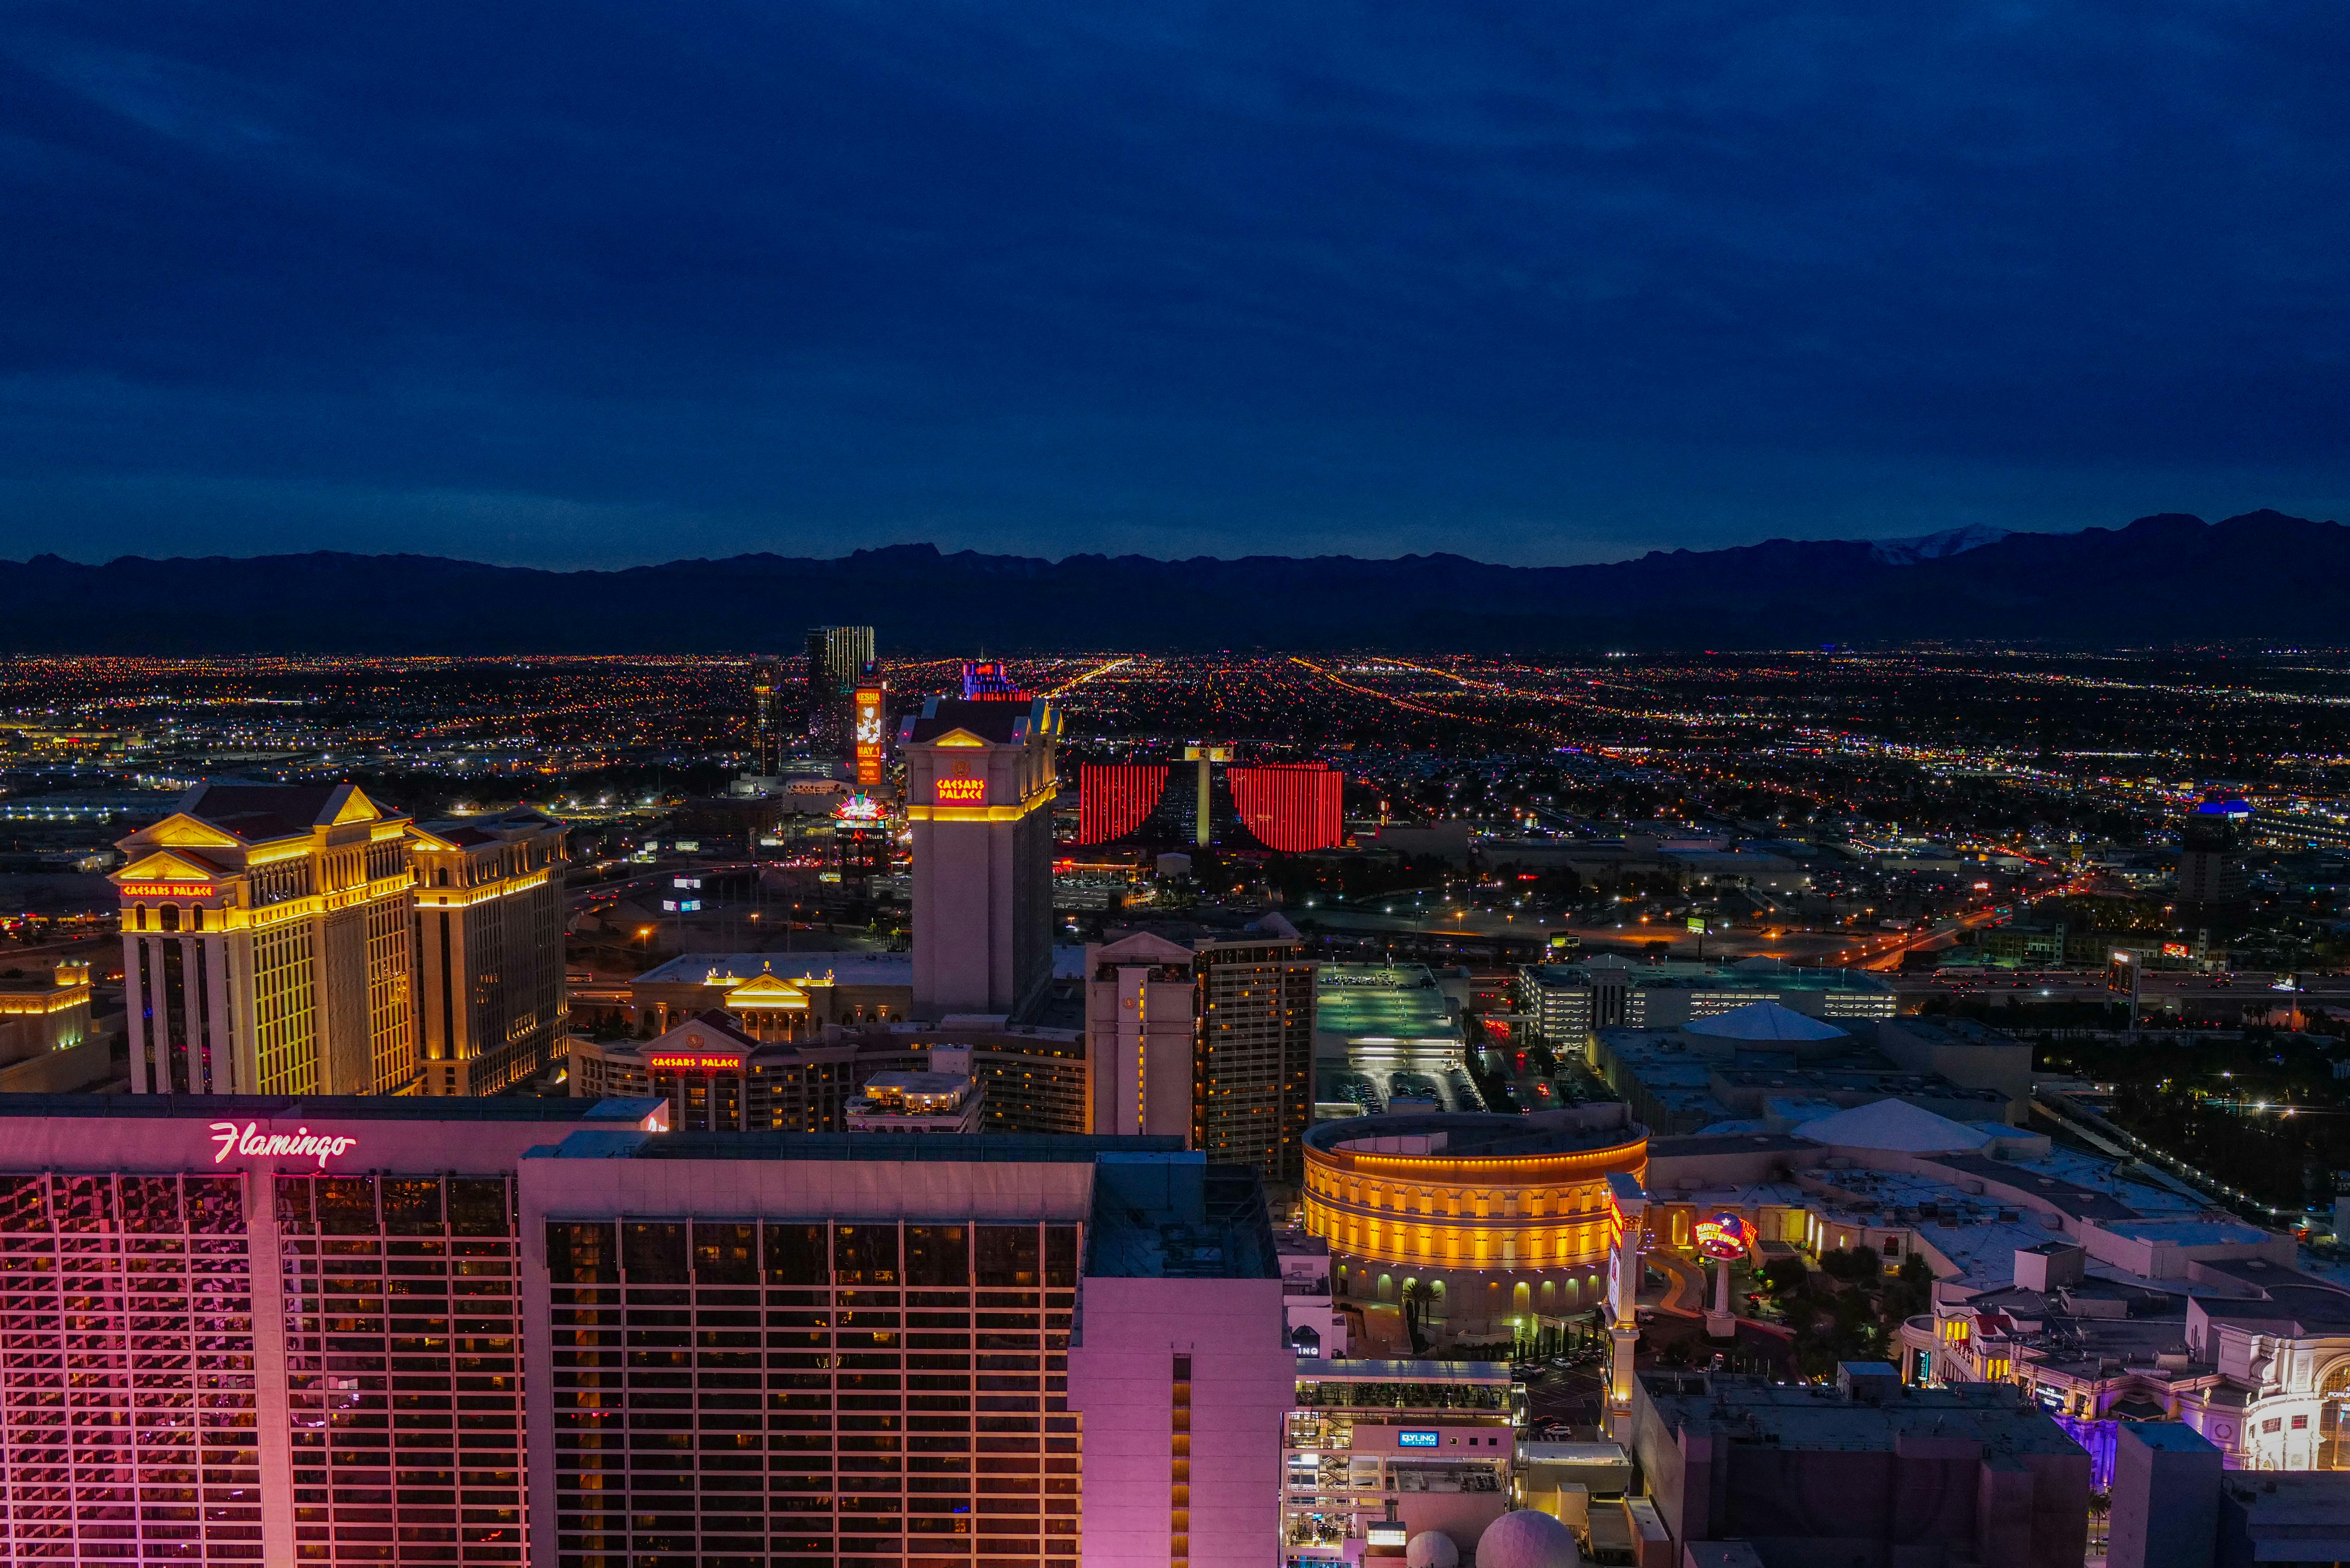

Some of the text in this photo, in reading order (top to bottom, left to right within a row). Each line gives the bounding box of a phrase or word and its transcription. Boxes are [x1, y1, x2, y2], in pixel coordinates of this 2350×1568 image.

[856, 693, 880, 701] KESHA
[857, 746, 874, 755] MAY
[936, 779, 985, 790] CAESARS
[939, 789, 982, 800] PALACE
[124, 886, 212, 896] CAESARS PALACE
[652, 1058, 739, 1067] CAESARS PALACE
[209, 1122, 356, 1168] Flamingo
[1695, 1223, 1723, 1238] PLANET
[1698, 1231, 1740, 1247] HOLLYWOOD
